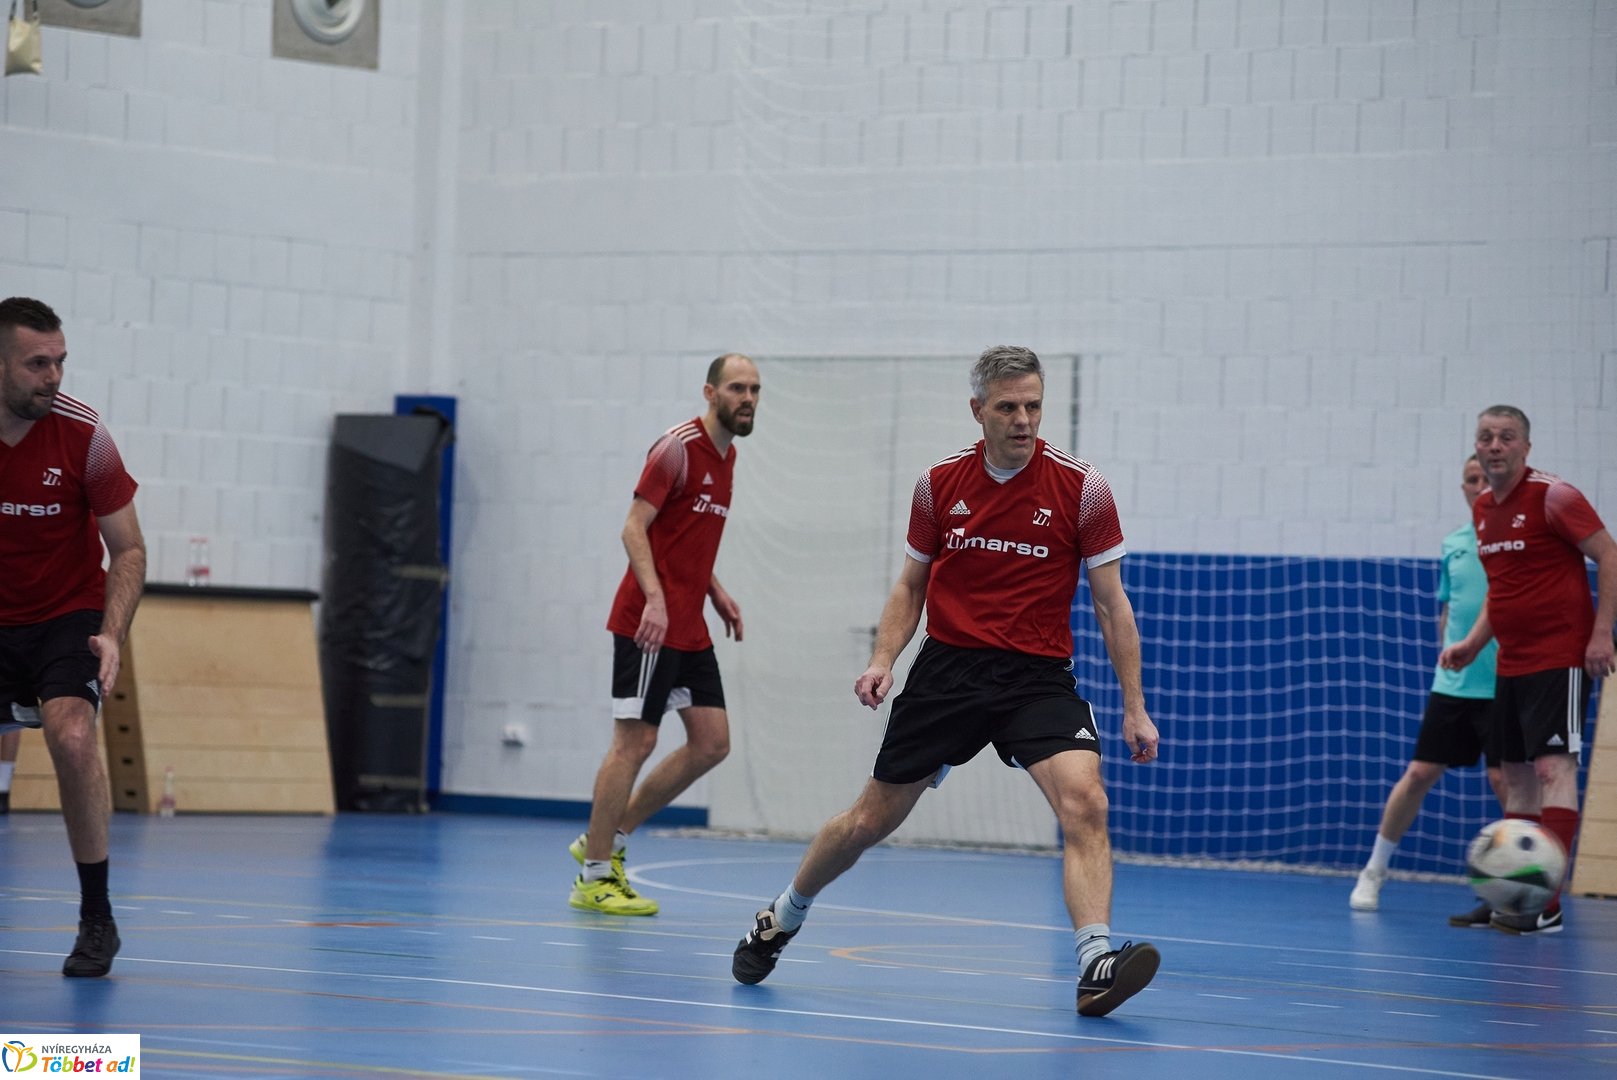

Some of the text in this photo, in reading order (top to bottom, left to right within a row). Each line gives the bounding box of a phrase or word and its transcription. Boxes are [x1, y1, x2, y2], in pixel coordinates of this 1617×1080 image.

[0, 502, 61, 516] arso
[964, 536, 1049, 558] marso
[1480, 540, 1526, 556] marso
